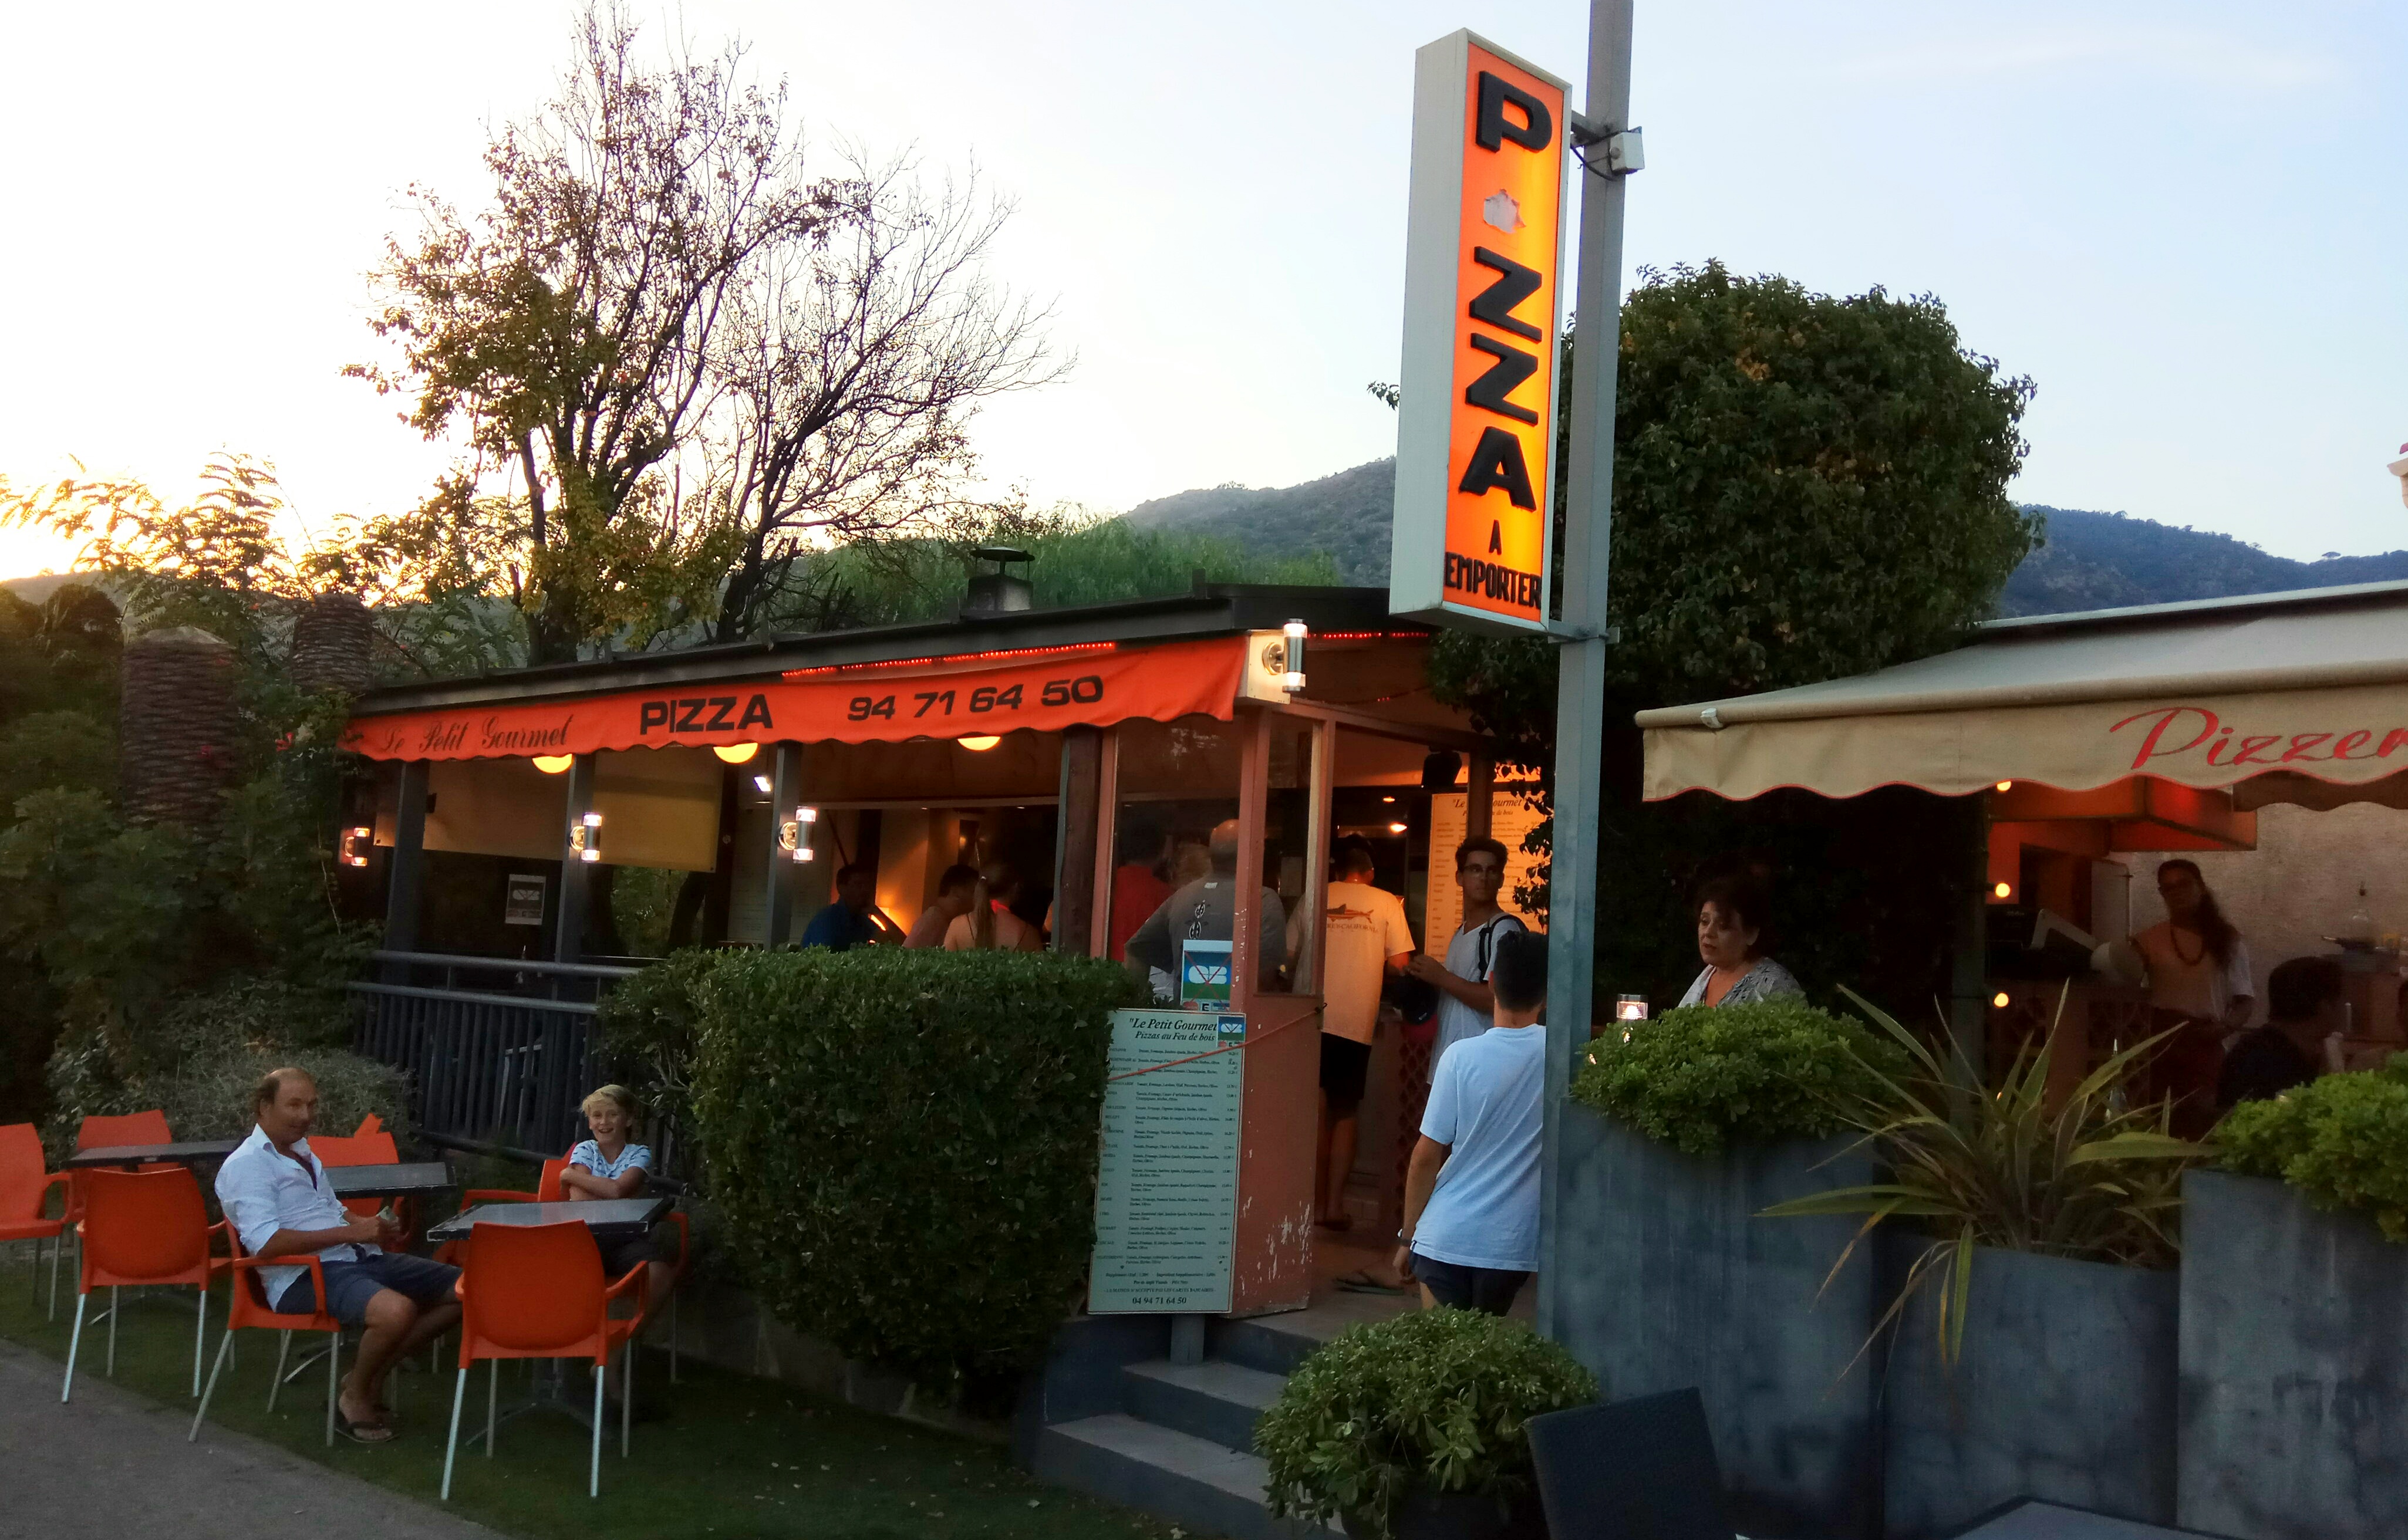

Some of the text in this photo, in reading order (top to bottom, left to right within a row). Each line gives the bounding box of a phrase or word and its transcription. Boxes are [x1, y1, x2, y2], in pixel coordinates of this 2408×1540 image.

[1458, 70, 1553, 512] PZZA
[1488, 519, 1502, 555] A
[1444, 551, 1542, 610] EMPORTER
[640, 693, 774, 735] PIZZA
[847, 675, 1104, 721] 94 71 64 50
[380, 714, 574, 754] Le Petit Gourmet
[1135, 1031, 1160, 1039] Pizzas
[1147, 1019, 1173, 1029] Petit
